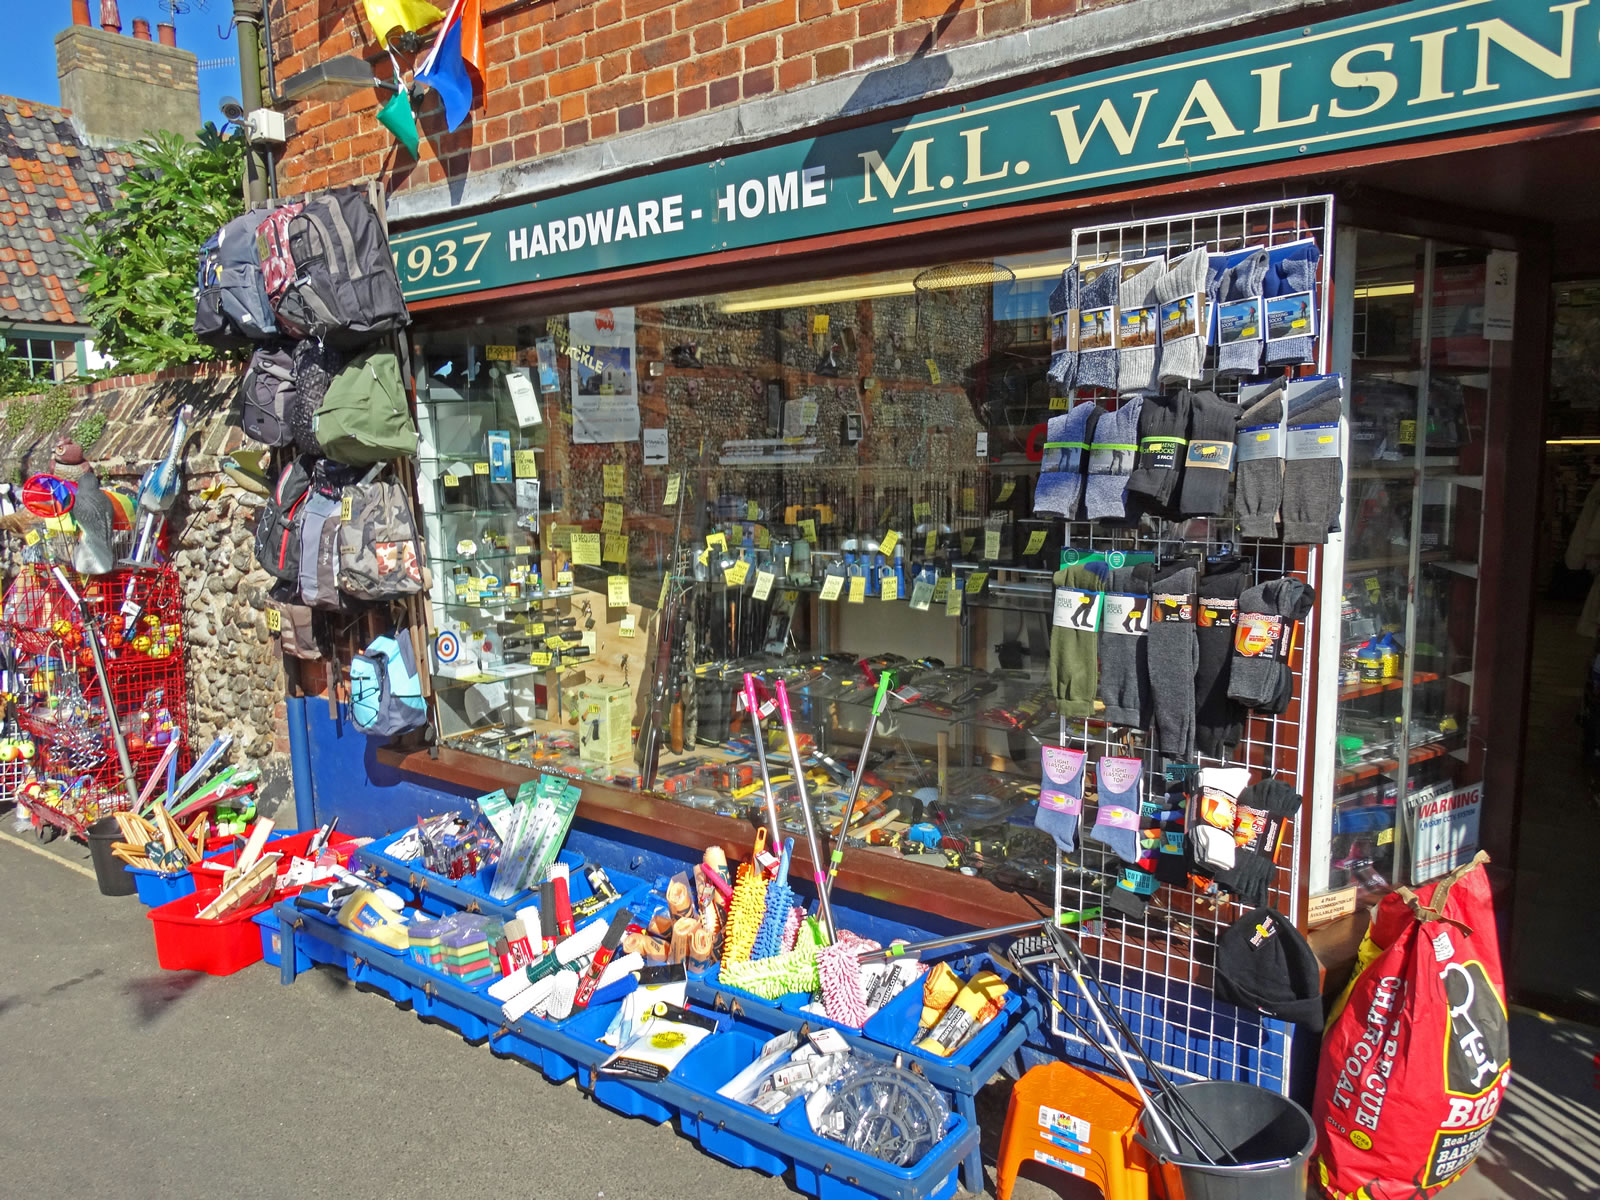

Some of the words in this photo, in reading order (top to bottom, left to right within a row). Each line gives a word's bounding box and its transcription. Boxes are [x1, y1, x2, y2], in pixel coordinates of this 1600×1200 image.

[857, 126, 1030, 204] M.L.
[1050, 0, 1600, 165] WALSIN
[508, 194, 684, 262] HARDWARE
[715, 164, 827, 222] HOME
[560, 341, 604, 374] TACKLE
[1418, 789, 1479, 819] WARNING
[1332, 975, 1401, 1109] CHARCOAL
[1440, 1087, 1499, 1128] BIG
[1441, 1134, 1468, 1148] Real
